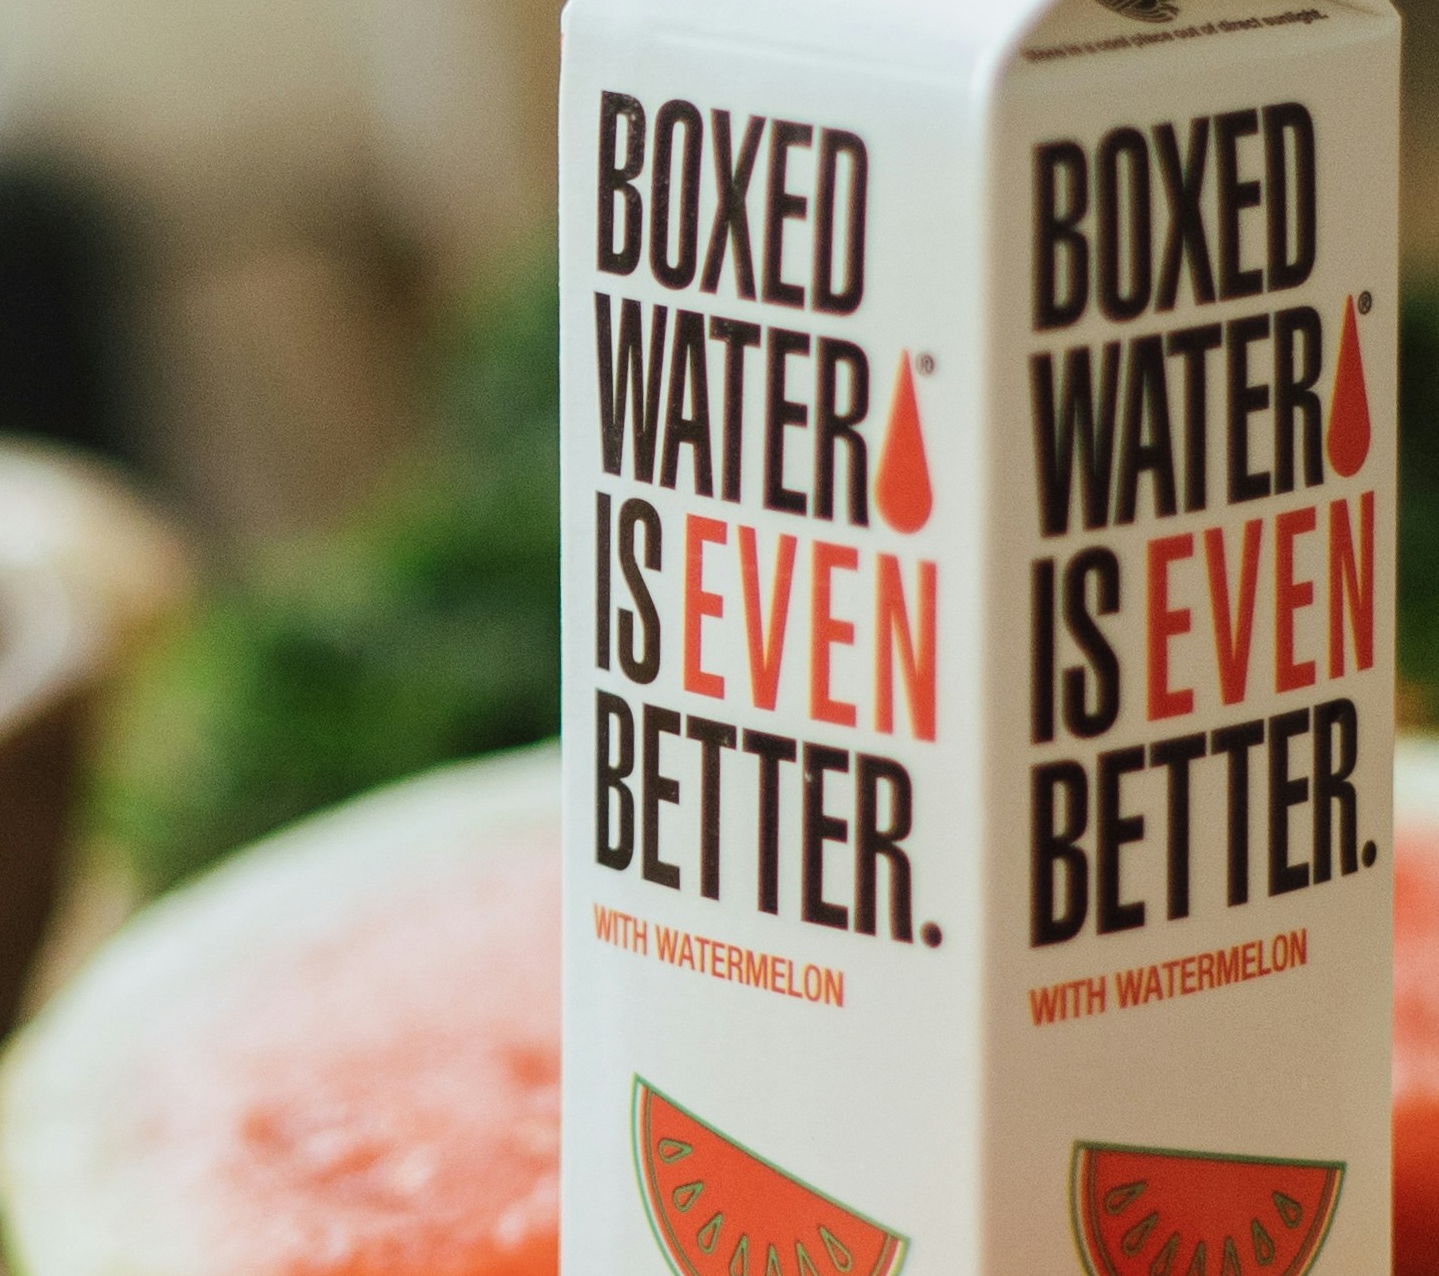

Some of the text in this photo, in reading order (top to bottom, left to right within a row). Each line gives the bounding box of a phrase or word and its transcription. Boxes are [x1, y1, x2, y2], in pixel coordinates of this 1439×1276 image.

[596, 90, 868, 318] BOXED
[1030, 100, 1319, 333] BOXED
[594, 291, 870, 529] WATER
[1028, 305, 1325, 539] WATER
[594, 490, 937, 743] IS EVEN
[1030, 490, 1376, 745] IS EVEN
[594, 688, 943, 948] BETTER.
[1029, 697, 1378, 950] BETTER.
[593, 902, 845, 1008] WITH WATERMELON
[1028, 927, 1309, 1027] WITH WATERMELON
